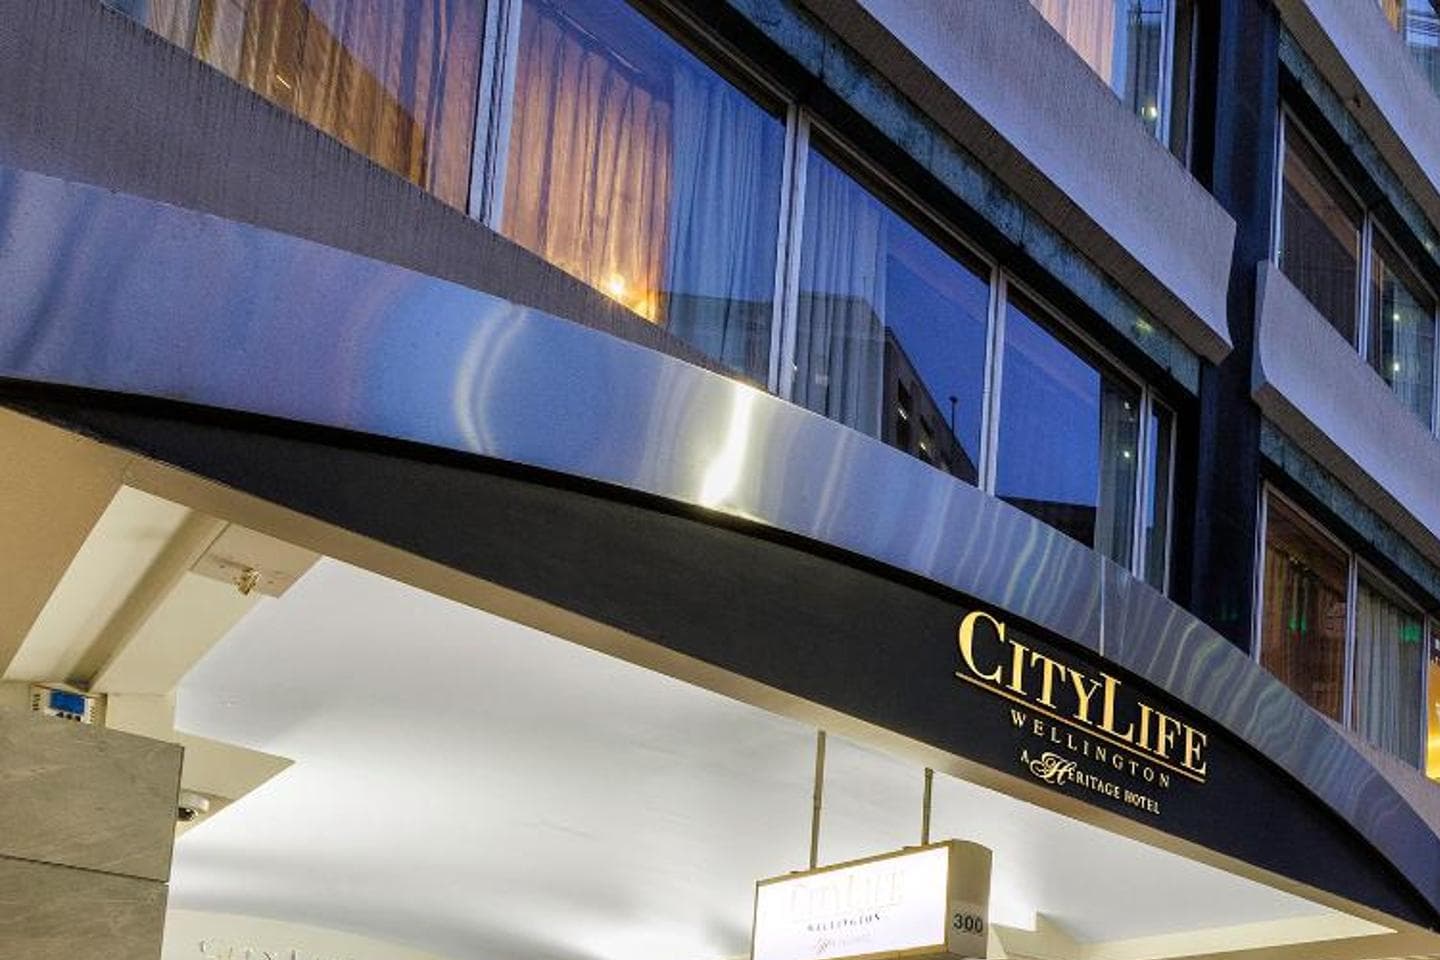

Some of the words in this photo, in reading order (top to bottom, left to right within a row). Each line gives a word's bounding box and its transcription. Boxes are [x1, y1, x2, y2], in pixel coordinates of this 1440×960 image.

[957, 611, 1209, 775] CITYLIFE
[1011, 708, 1171, 788] WELLINGTON
[1020, 749, 1030, 764] A
[1030, 752, 1121, 800] HERITAGE
[1124, 789, 1161, 815] HOTEL
[953, 912, 985, 934] 300
